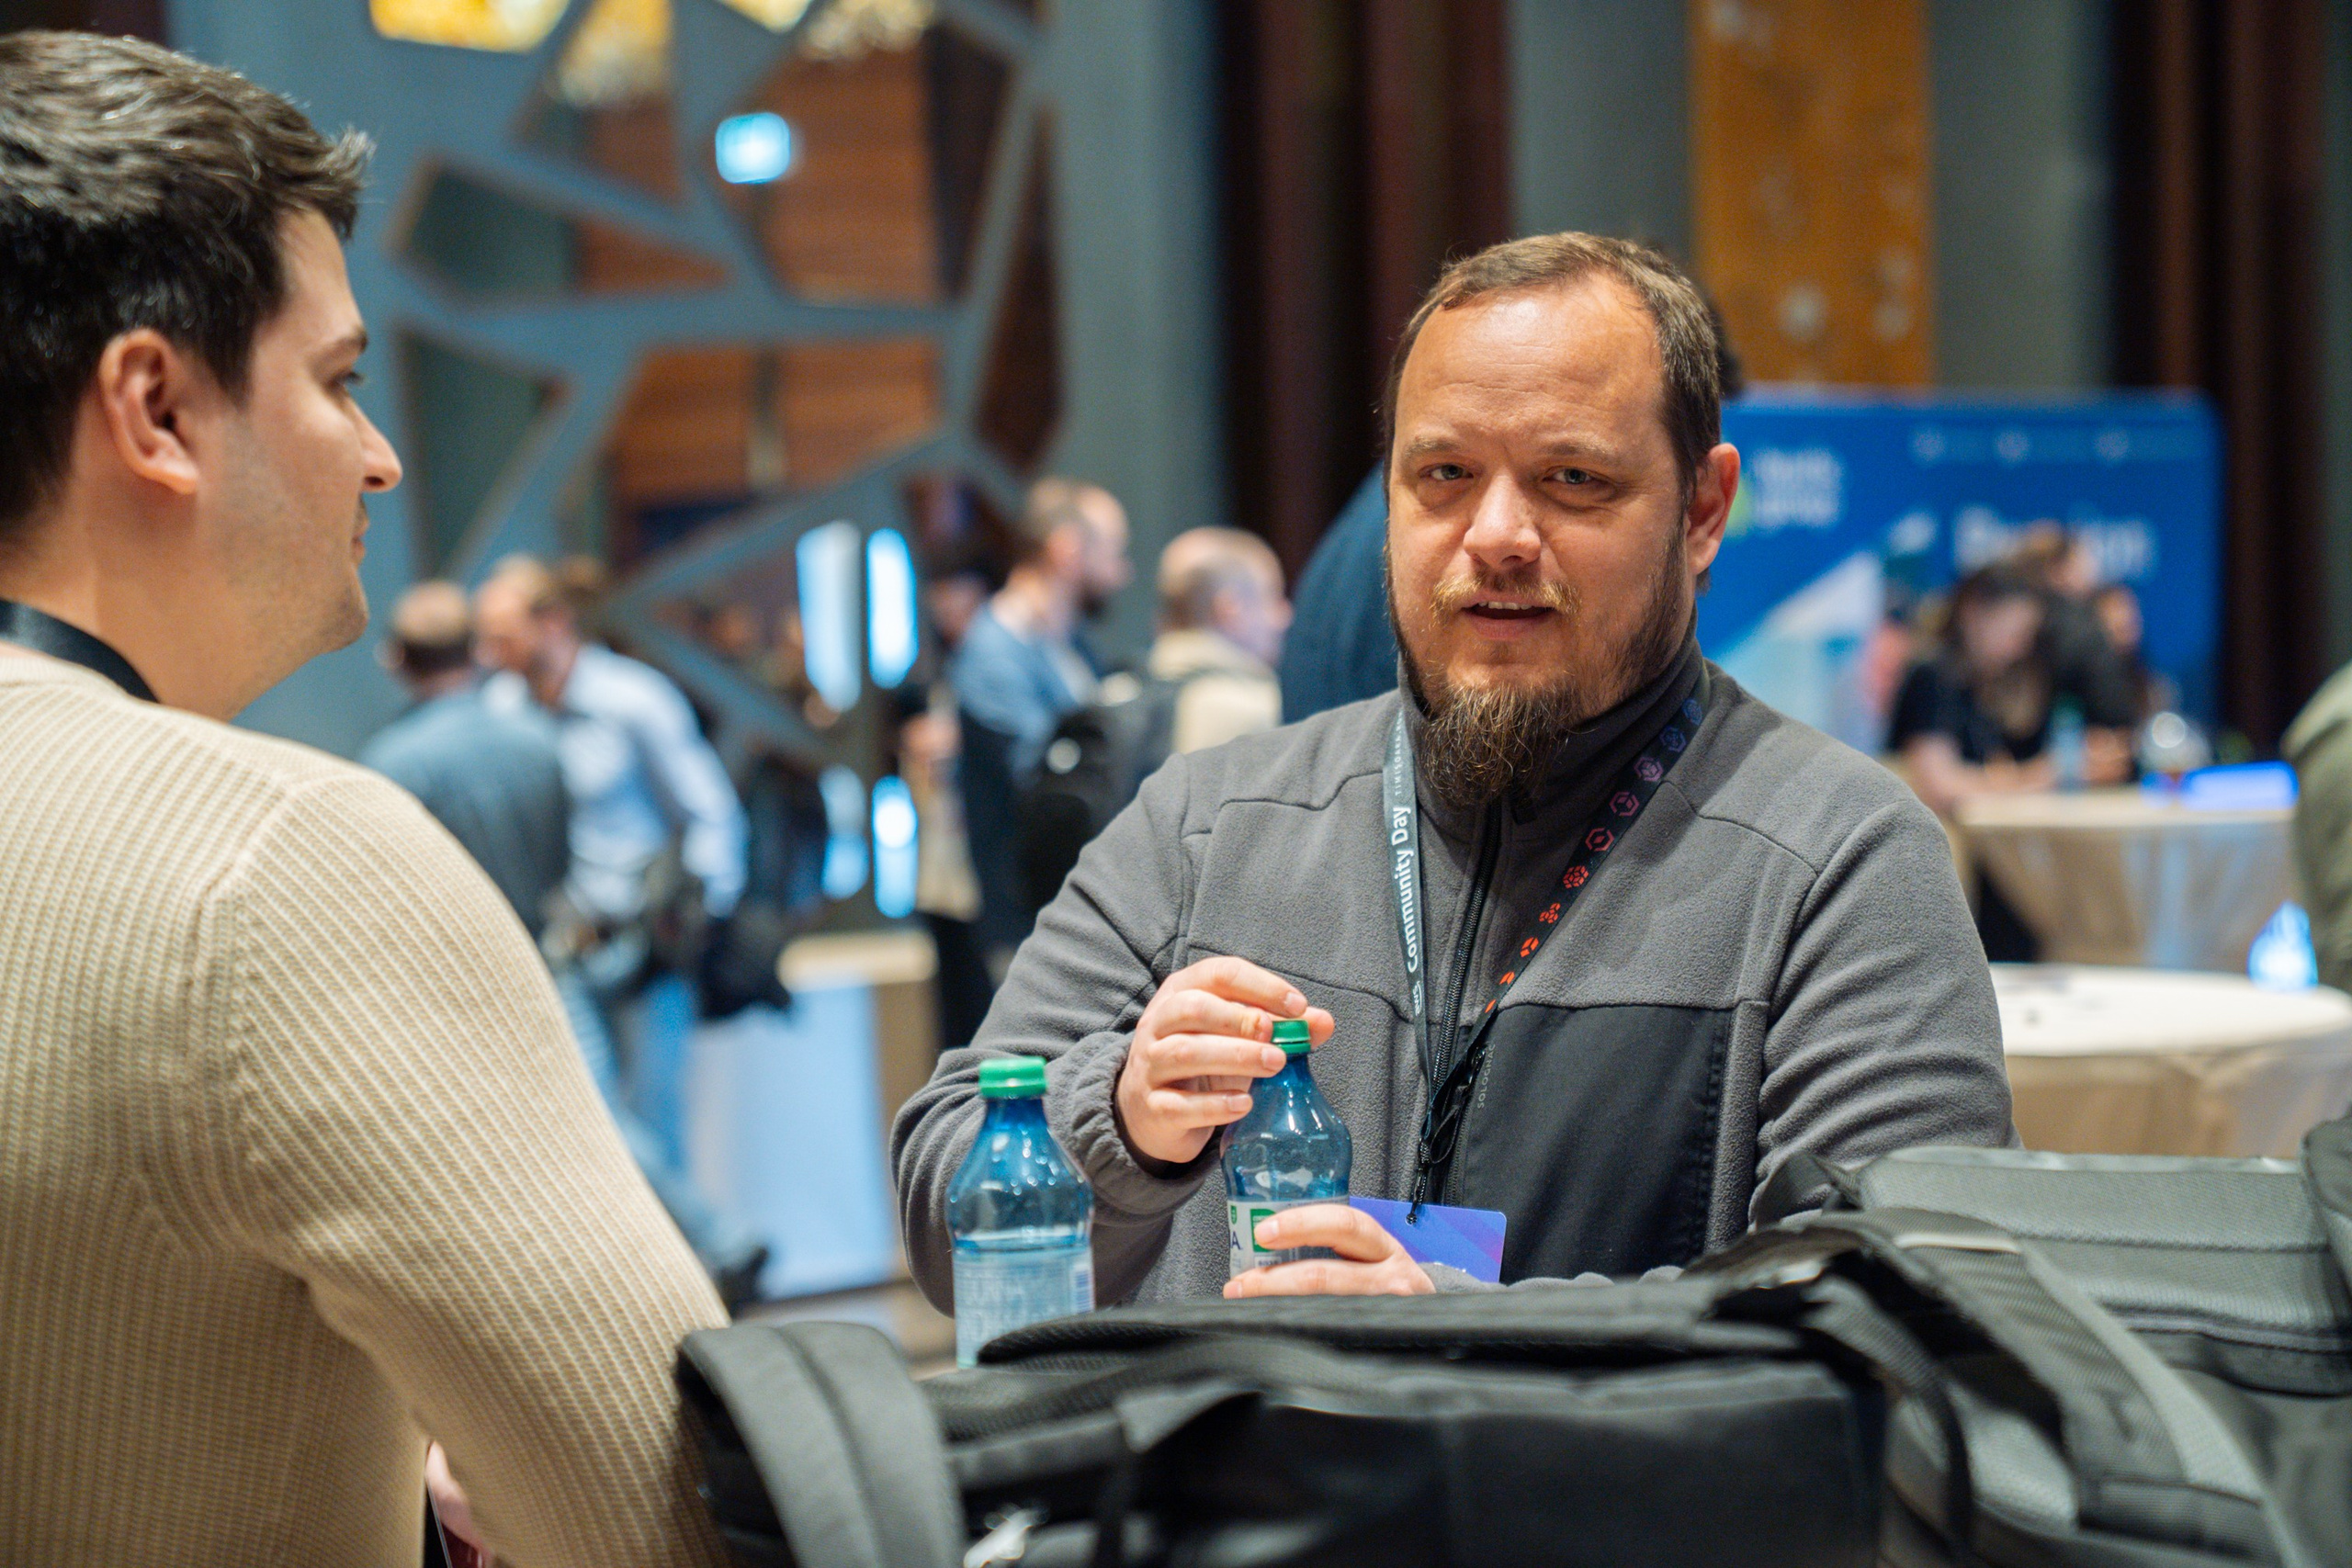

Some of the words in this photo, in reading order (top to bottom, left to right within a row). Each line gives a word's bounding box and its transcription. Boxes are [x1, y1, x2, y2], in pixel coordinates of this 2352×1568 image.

[1392, 807, 1411, 845] Day
[1394, 850, 1419, 973] Community
[1477, 1043, 1496, 1109] SOLOGNAC
